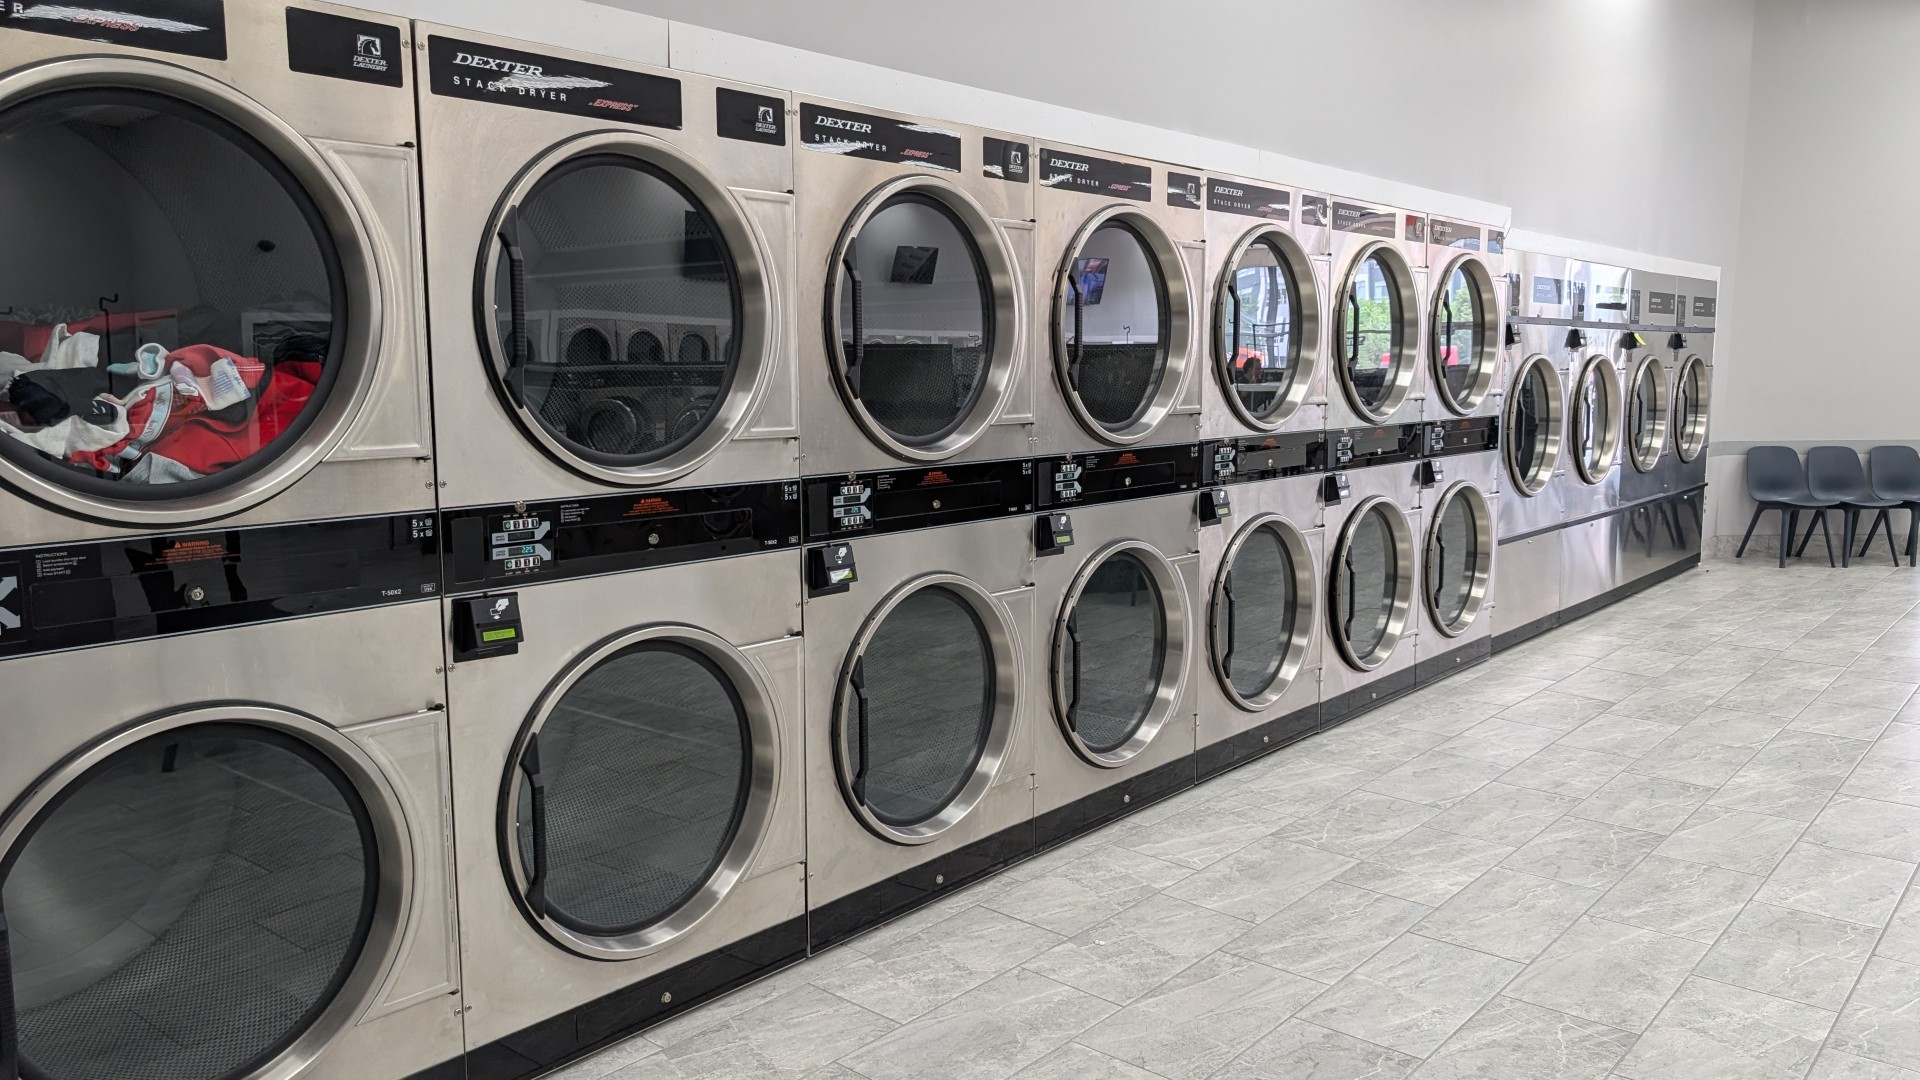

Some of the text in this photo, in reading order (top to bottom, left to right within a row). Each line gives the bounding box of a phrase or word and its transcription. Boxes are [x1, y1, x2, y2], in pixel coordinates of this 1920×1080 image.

[353, 55, 388, 66] DEXTER
[353, 62, 388, 71] LAUNDRY
[453, 53, 543, 77] DEXTER
[518, 87, 567, 102] DRYER
[815, 115, 872, 133] DEXTER
[1050, 158, 1089, 171] DEXTER
[1214, 185, 1244, 197] DEXTER
[412, 519, 418, 527] 5
[412, 530, 418, 538] 5
